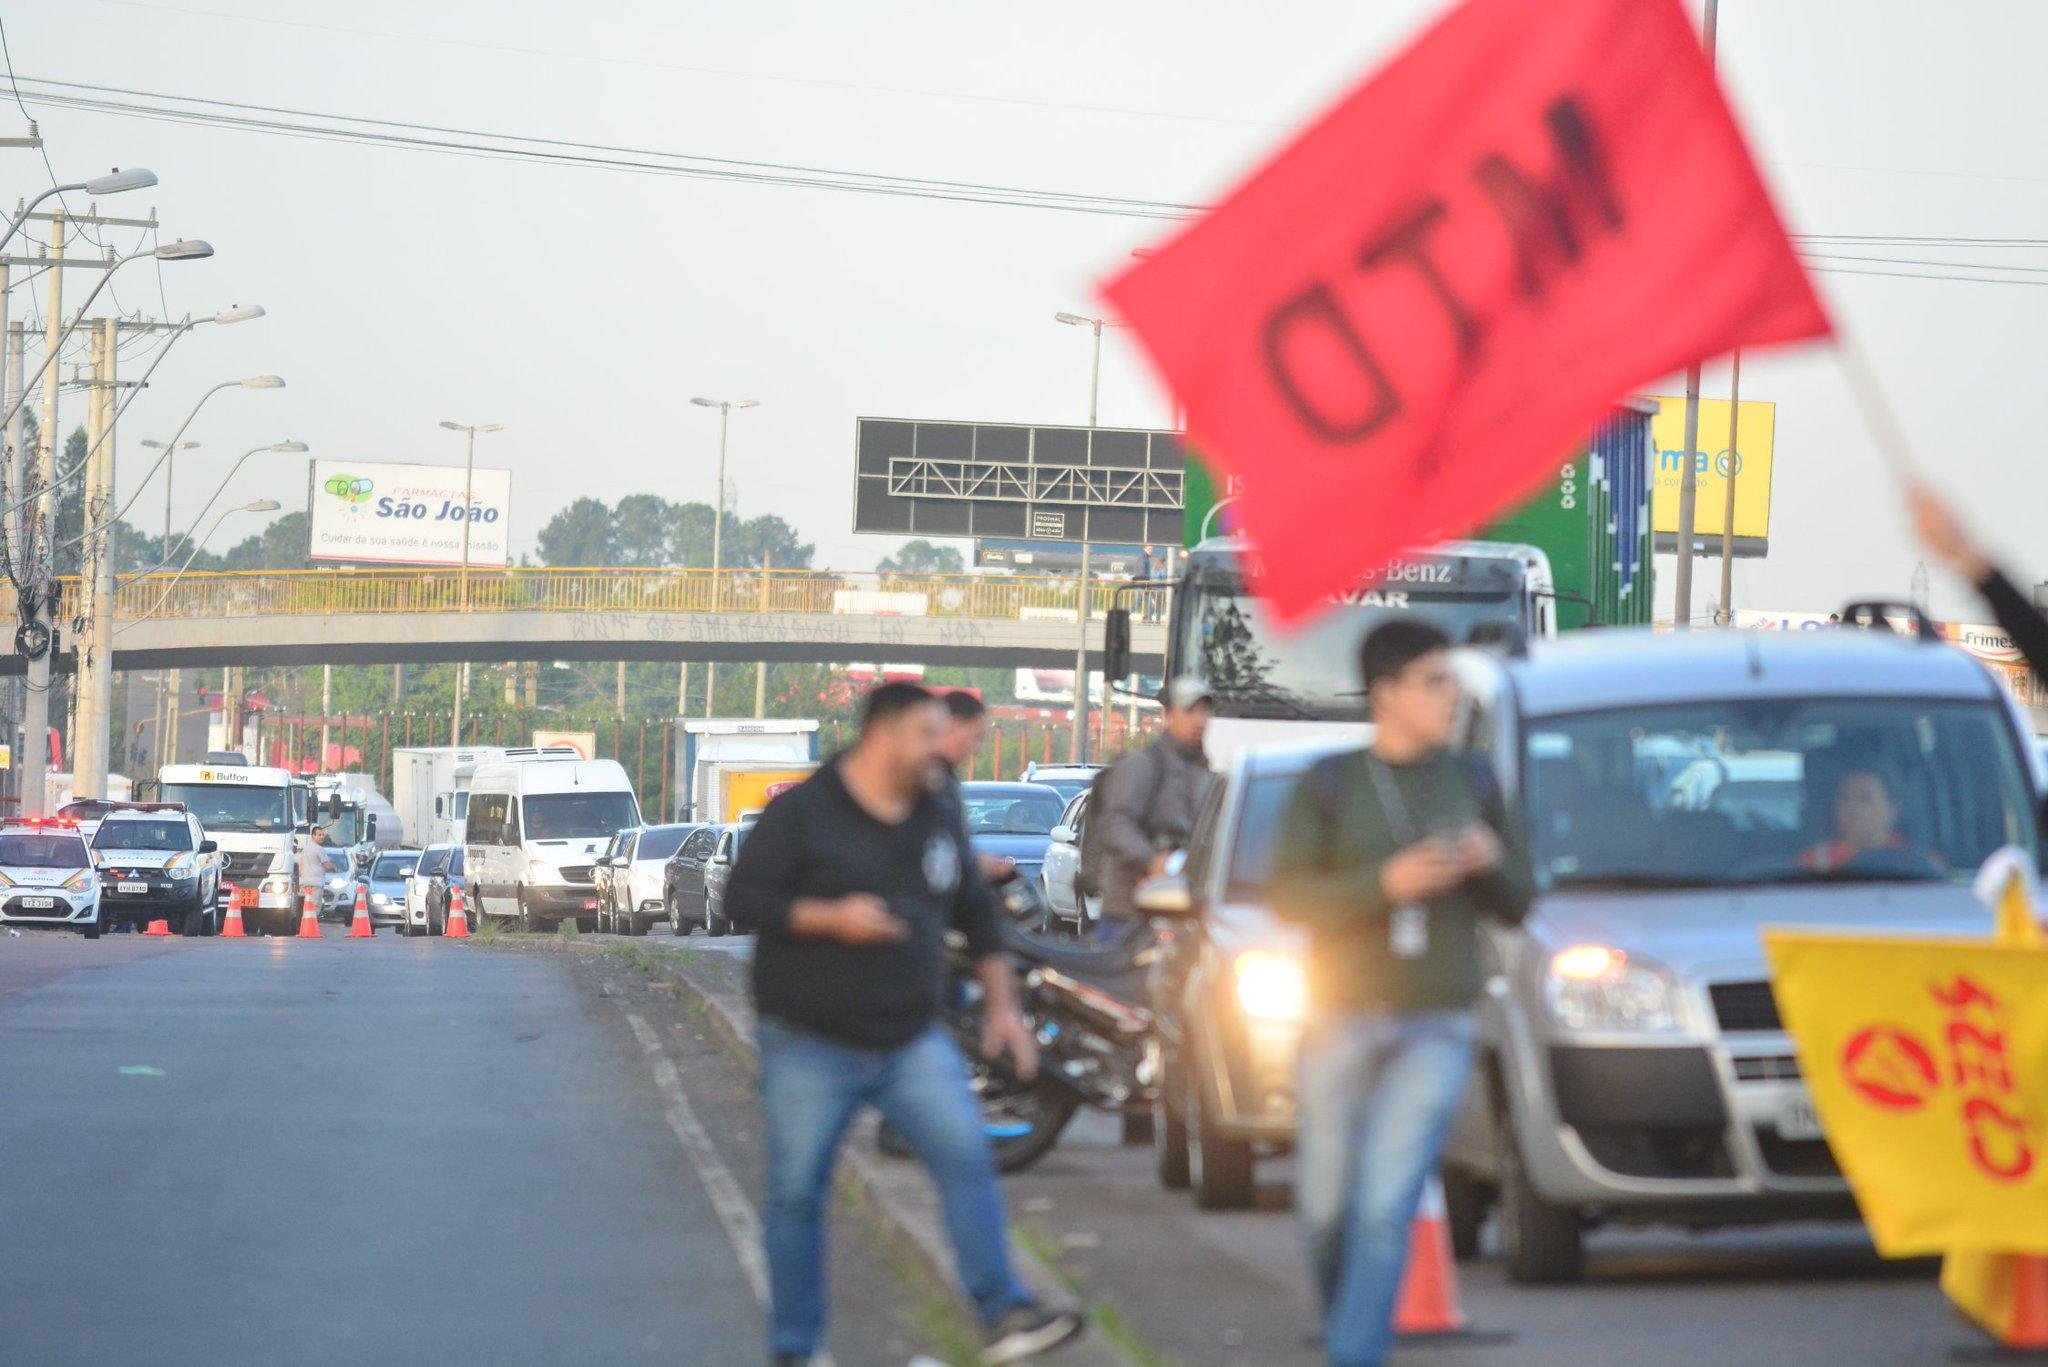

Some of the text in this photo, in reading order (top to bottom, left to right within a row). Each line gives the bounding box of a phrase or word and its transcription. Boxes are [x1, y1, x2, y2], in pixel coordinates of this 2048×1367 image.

[376, 497, 499, 523] São João
[321, 533, 351, 544] Cuidar
[355, 535, 367, 545] da
[369, 538, 387, 546] sua
[390, 536, 419, 547] saúde
[431, 540, 460, 549] nossa
[1964, 631, 2017, 649] Frimes
[216, 772, 248, 782] Buffon
